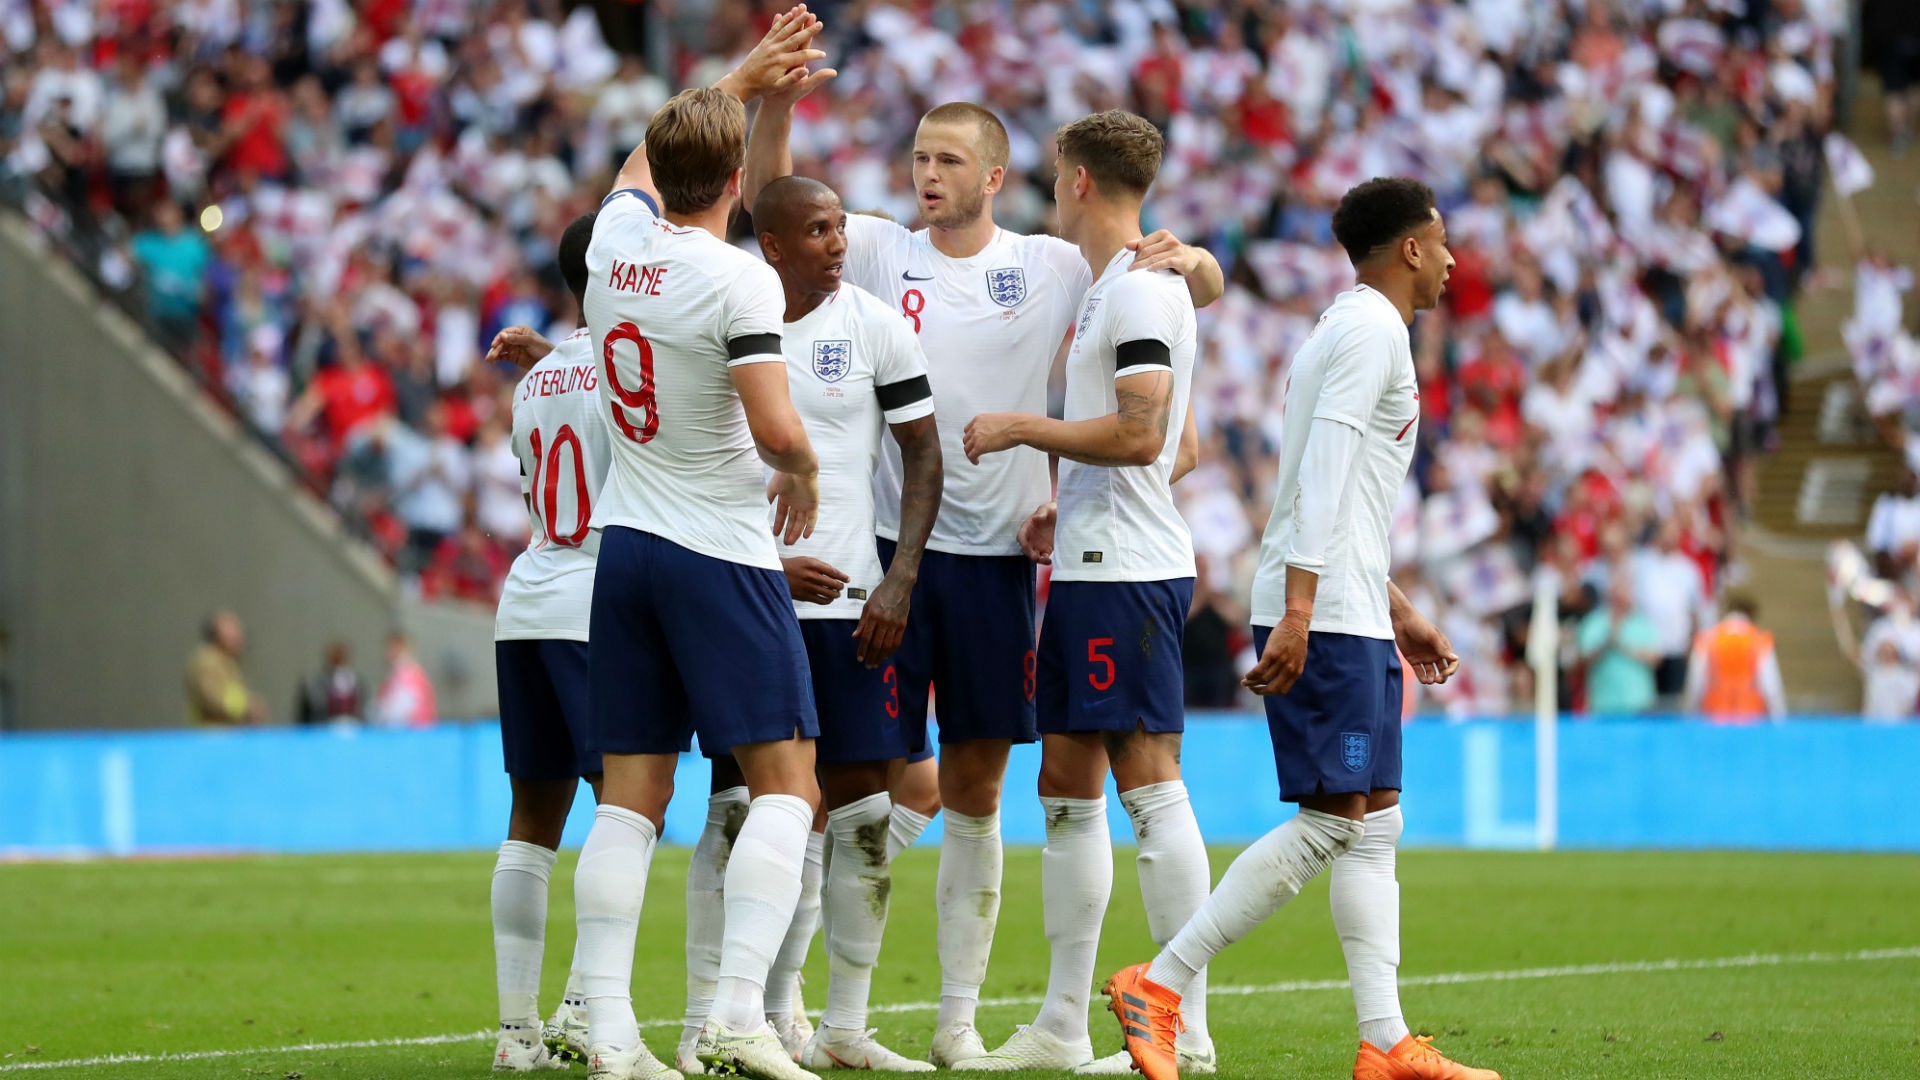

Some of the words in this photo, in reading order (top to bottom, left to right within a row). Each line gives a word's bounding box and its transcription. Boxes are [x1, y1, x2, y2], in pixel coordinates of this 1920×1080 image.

[609, 259, 668, 296] KANE
[901, 288, 925, 334] 8
[522, 366, 598, 401] STERLING
[603, 321, 660, 444] 9
[529, 424, 591, 549] 10
[1023, 649, 1037, 702] 8
[1087, 637, 1116, 691] 5
[882, 665, 899, 719] 3
